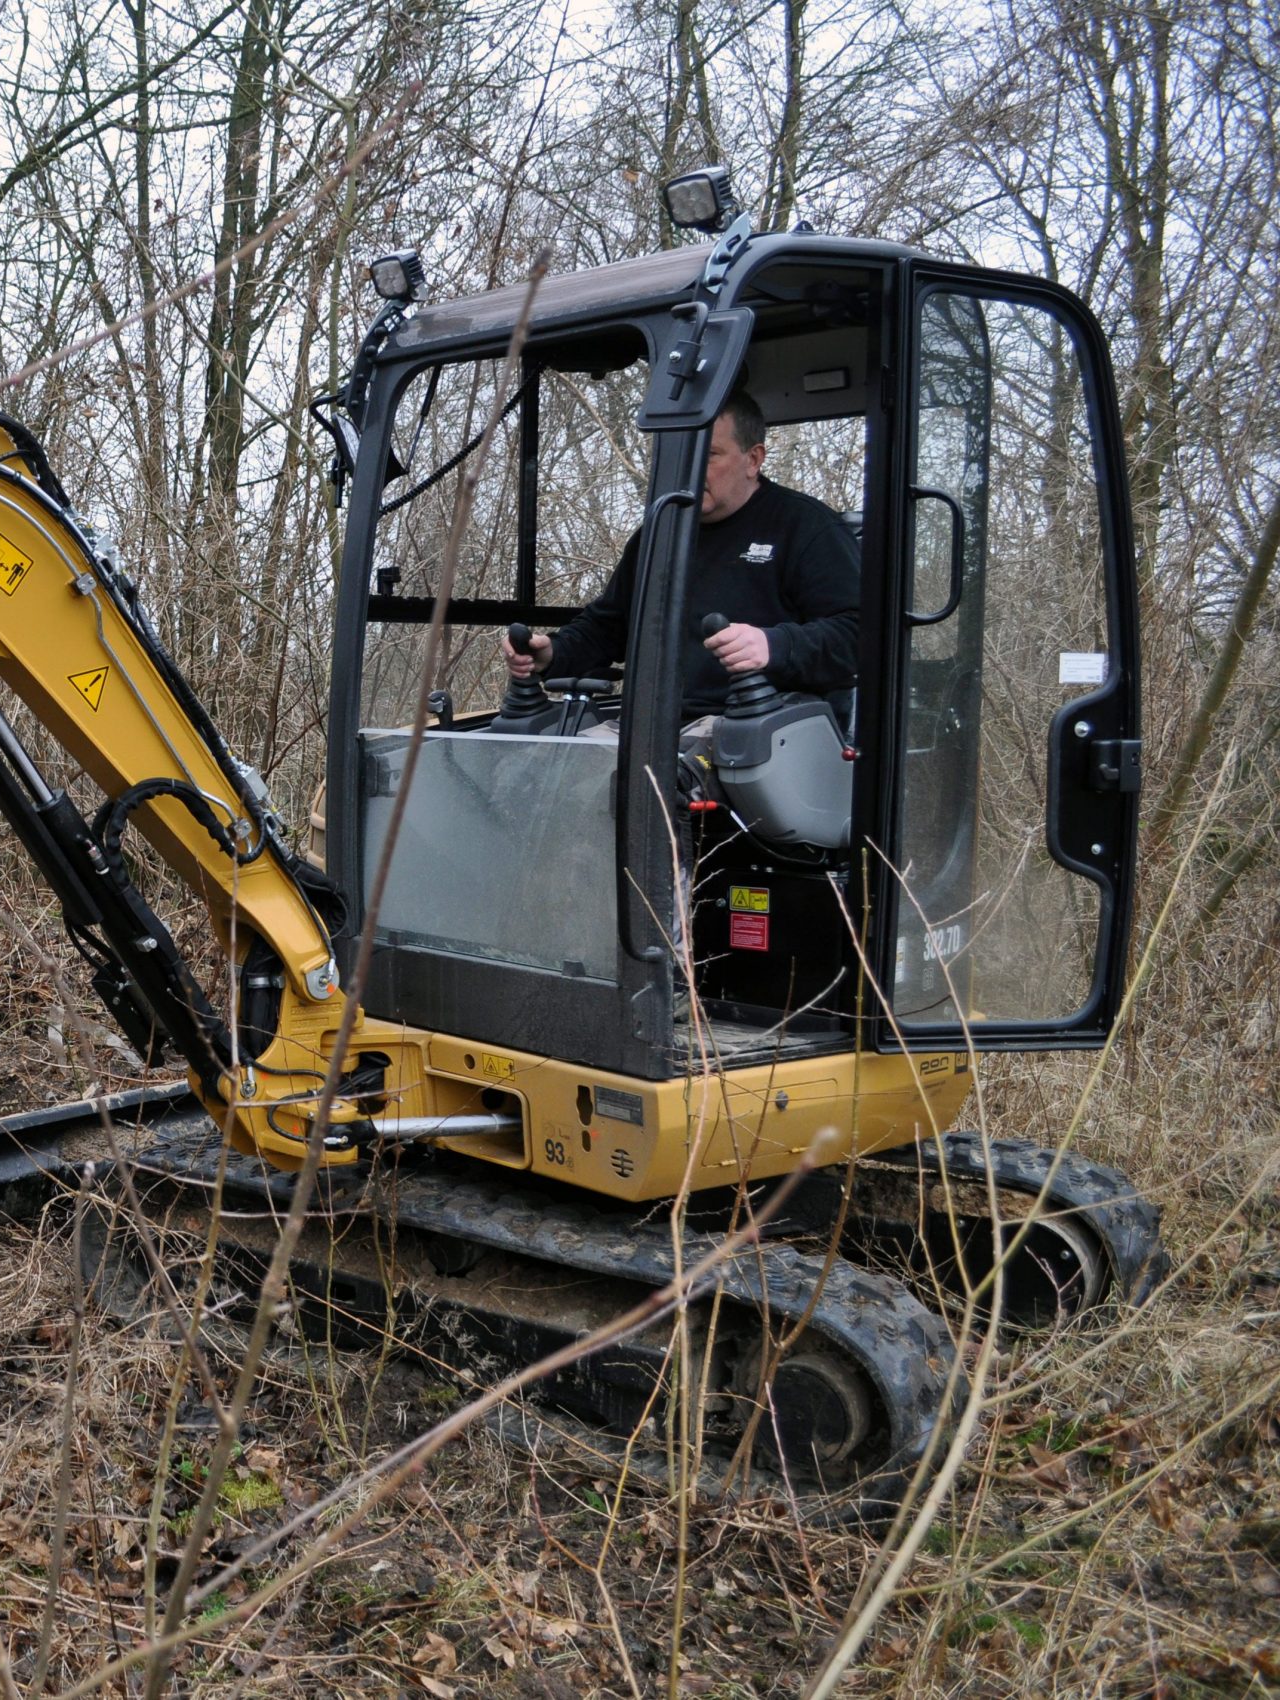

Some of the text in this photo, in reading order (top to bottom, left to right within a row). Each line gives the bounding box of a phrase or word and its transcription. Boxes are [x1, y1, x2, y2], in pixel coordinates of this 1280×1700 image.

[923, 925, 961, 961] 302.7D
[920, 1056, 949, 1076] pon
[545, 1139, 565, 1165] 93
